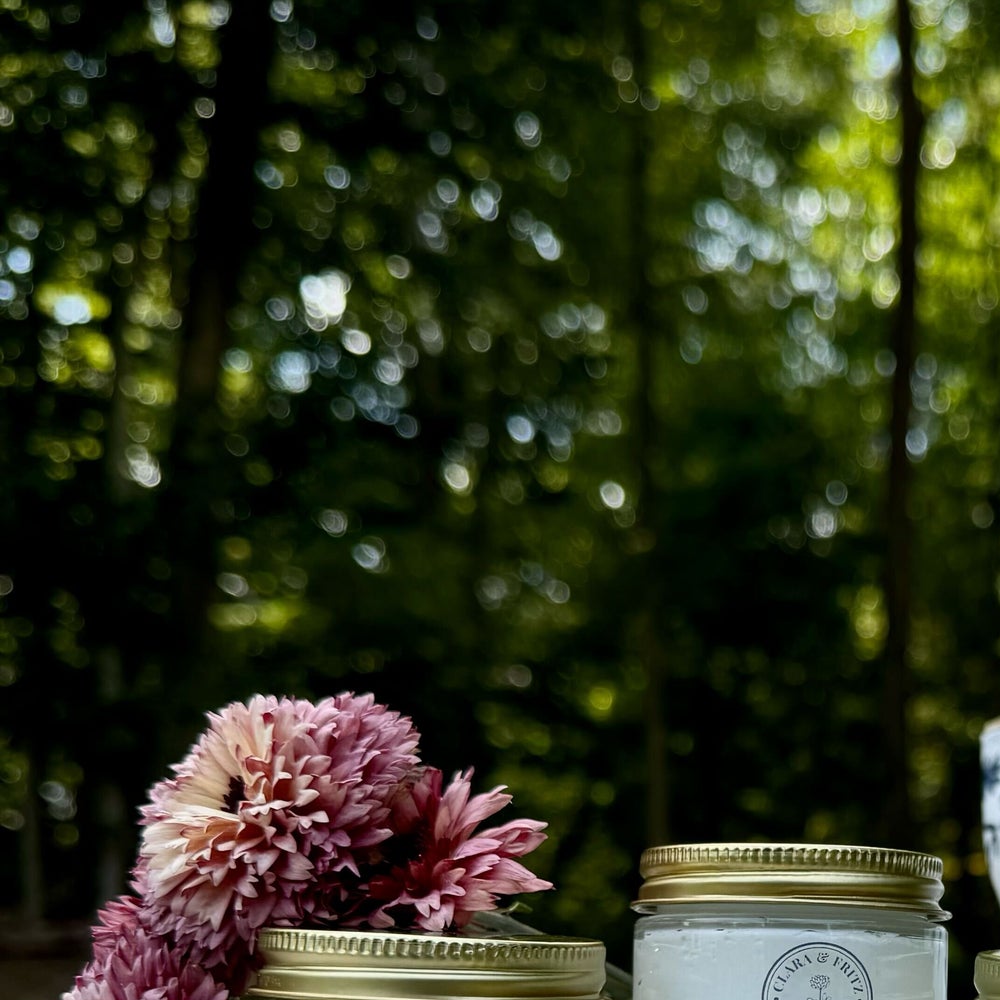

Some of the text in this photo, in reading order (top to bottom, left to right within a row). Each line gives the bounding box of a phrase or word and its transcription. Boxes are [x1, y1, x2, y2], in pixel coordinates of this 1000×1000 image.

[773, 952, 864, 994] CLARA & FRITZ
